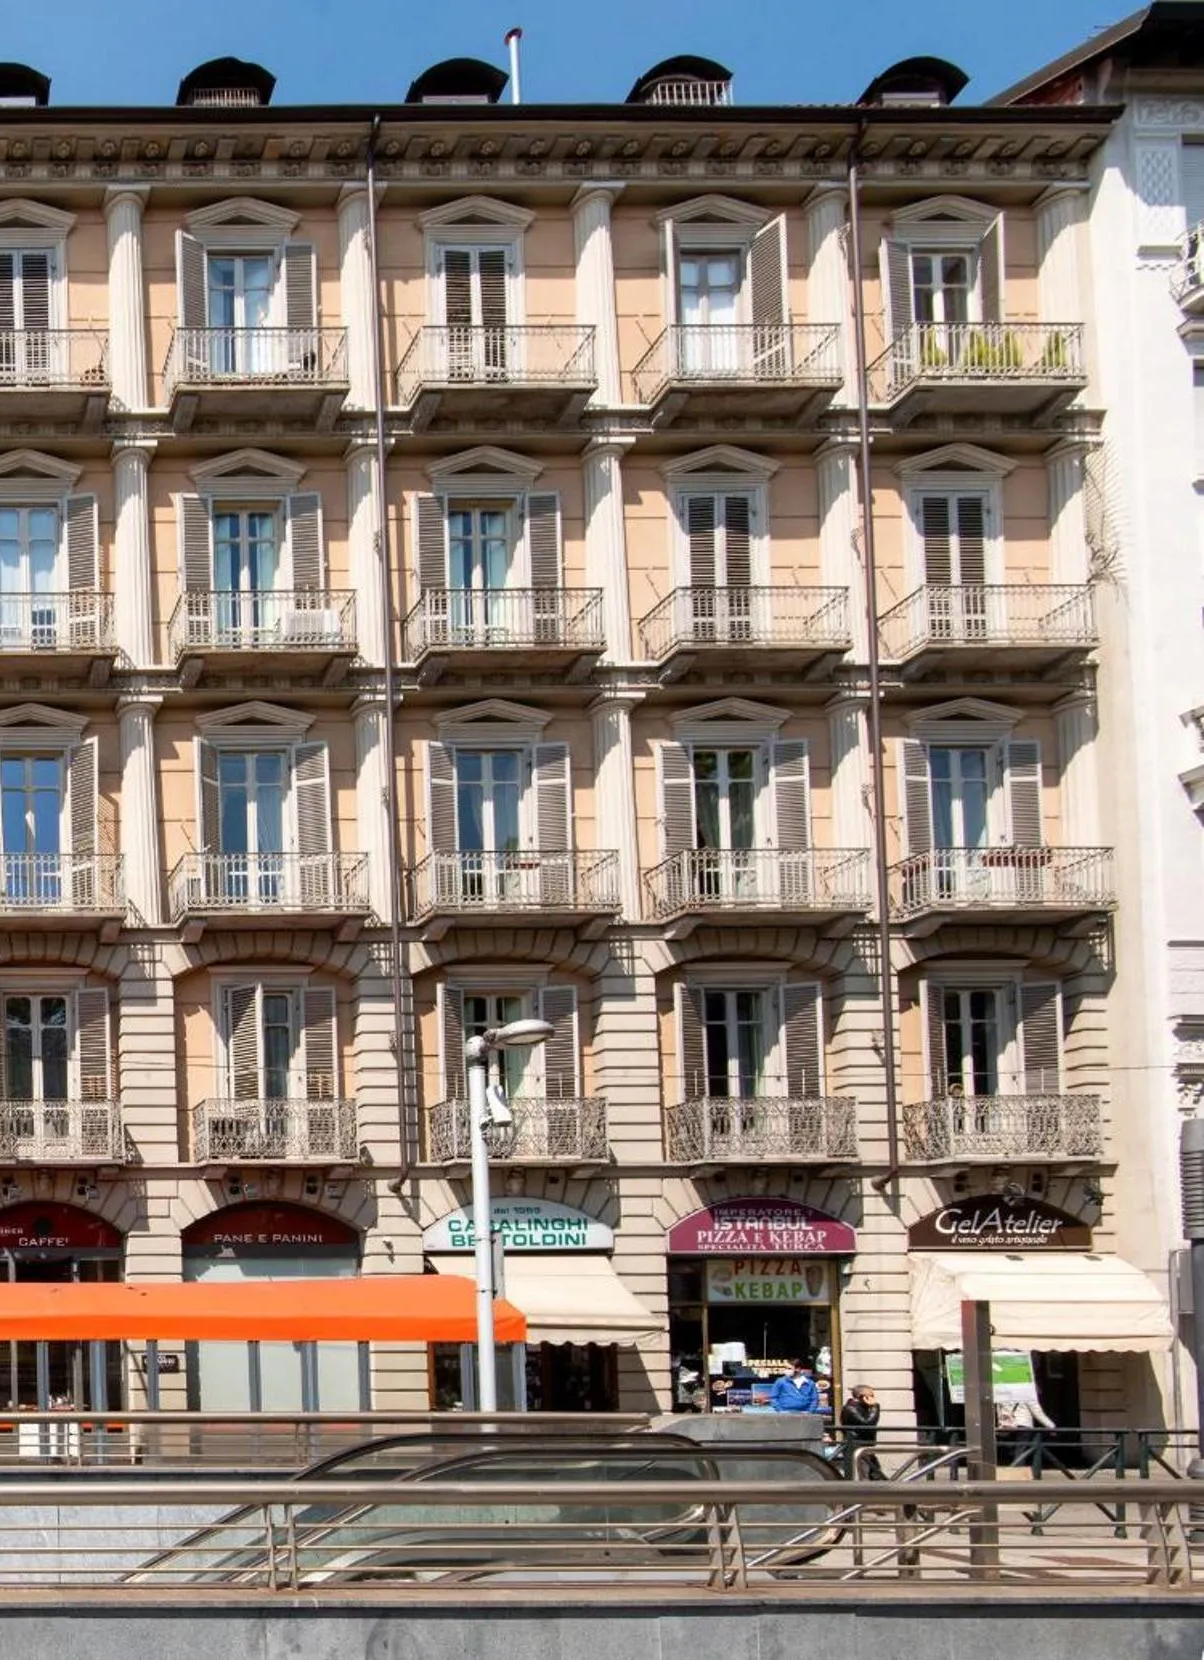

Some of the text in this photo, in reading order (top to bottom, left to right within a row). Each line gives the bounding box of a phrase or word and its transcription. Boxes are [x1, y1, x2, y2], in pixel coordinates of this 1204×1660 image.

[935, 1207, 1064, 1235] GelAtelier
[214, 1233, 324, 1243] PANE E PANINI
[451, 1232, 587, 1247] BETOLDINI
[697, 1230, 748, 1244] PIZZA
[769, 1229, 828, 1243] KEBAP
[733, 1259, 803, 1276] PIZZA
[733, 1281, 804, 1299] KEBAP
